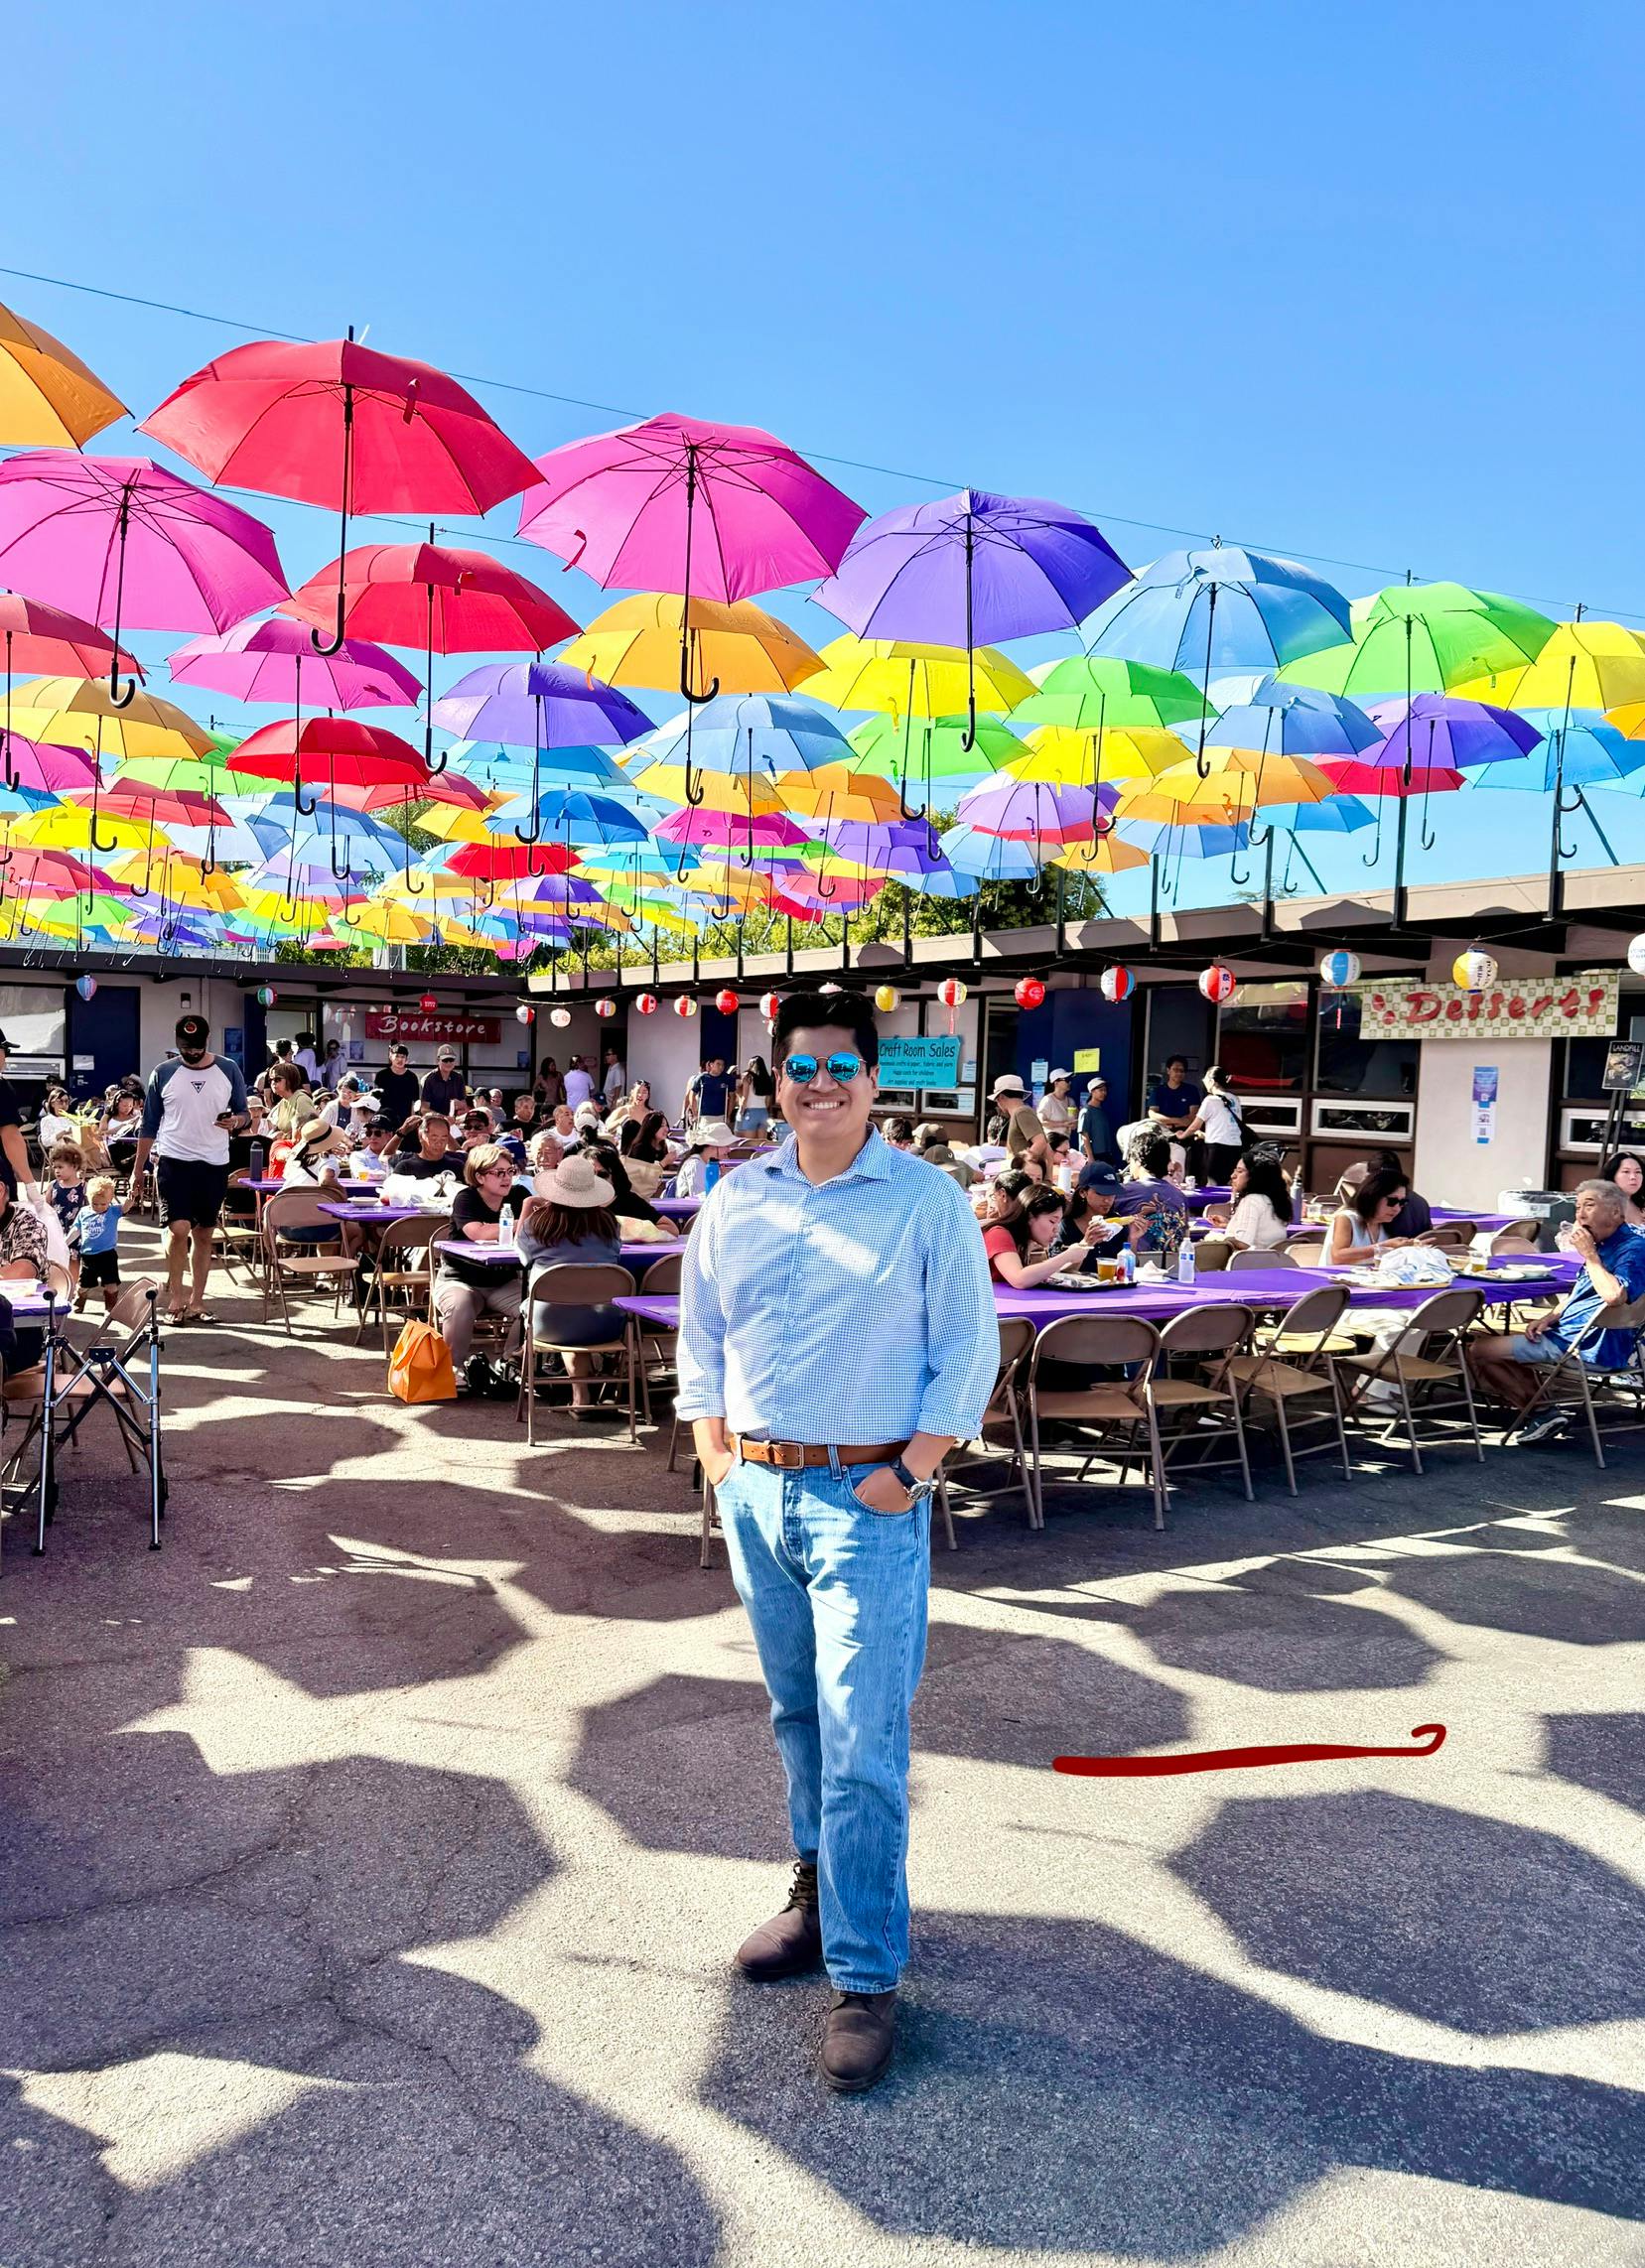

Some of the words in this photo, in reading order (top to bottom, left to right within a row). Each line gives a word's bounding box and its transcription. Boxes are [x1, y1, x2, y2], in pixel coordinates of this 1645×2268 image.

[1406, 988, 1604, 1023] Desserts
[378, 1015, 485, 1034] Bookstore
[880, 1042, 901, 1058] Craft
[903, 1042, 925, 1058] Room
[928, 1042, 956, 1058] Sales
